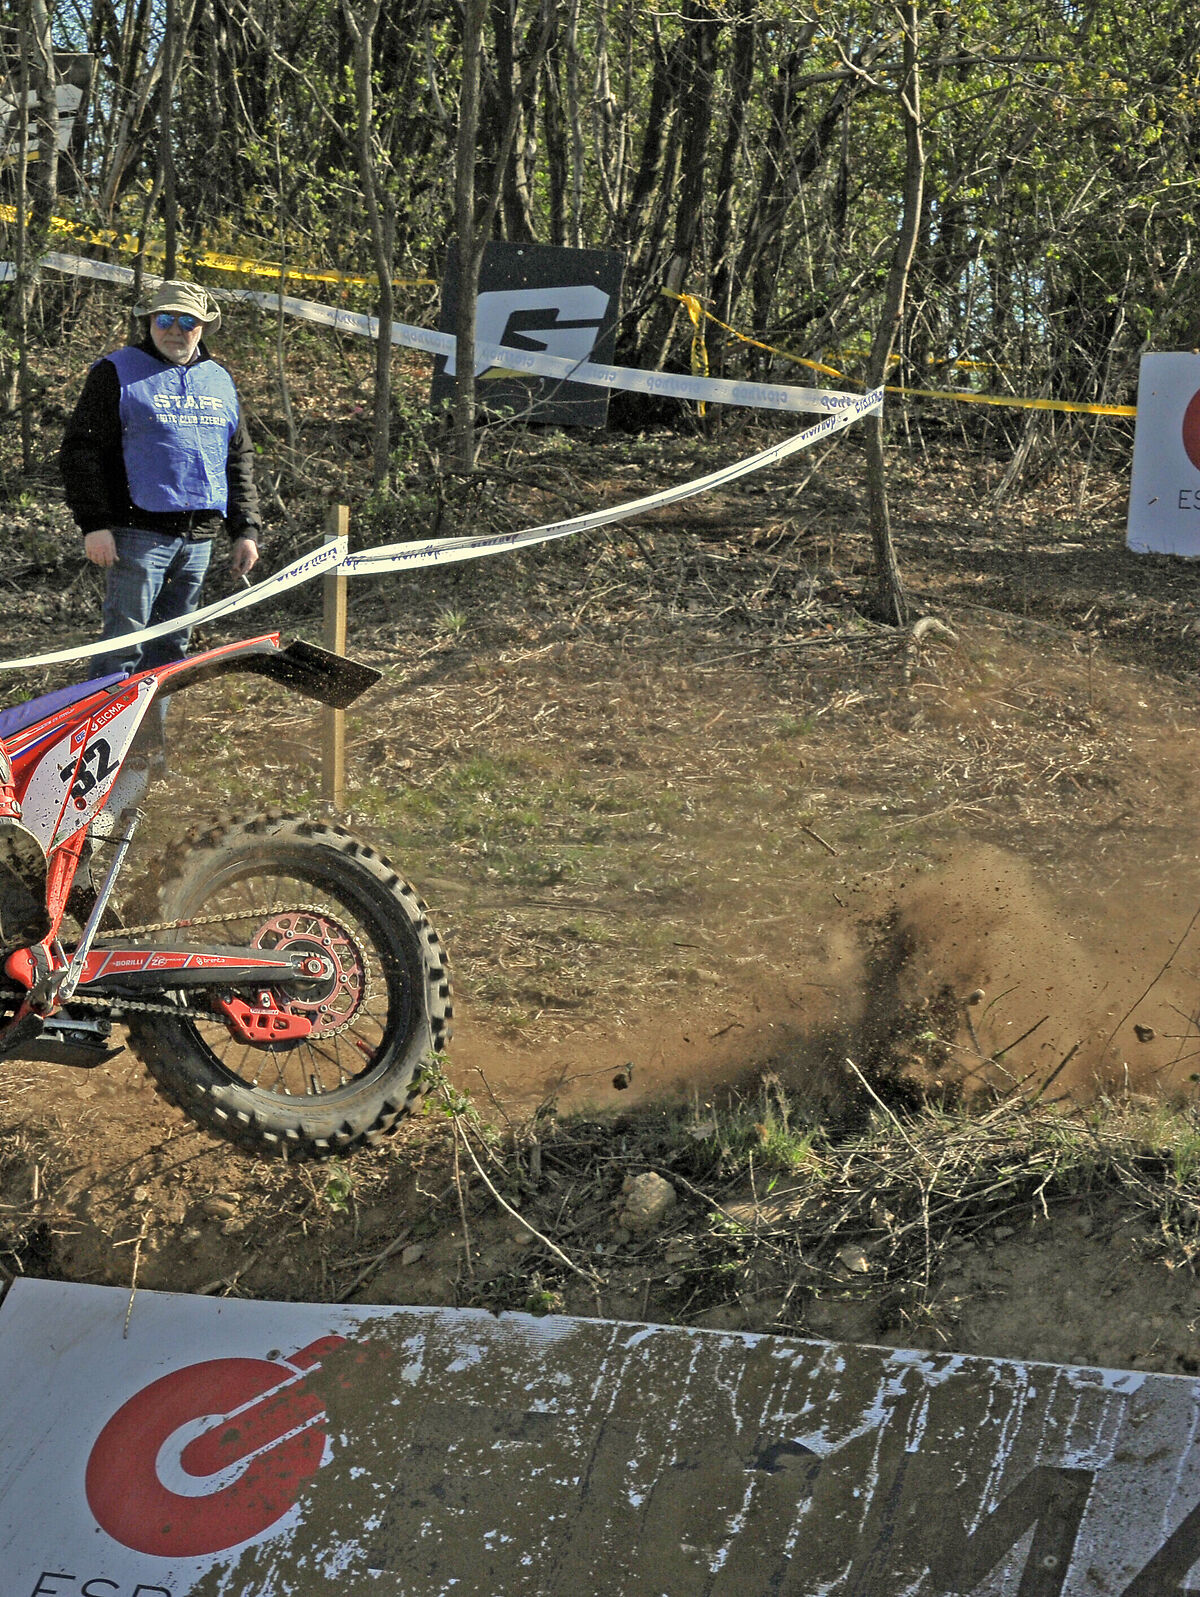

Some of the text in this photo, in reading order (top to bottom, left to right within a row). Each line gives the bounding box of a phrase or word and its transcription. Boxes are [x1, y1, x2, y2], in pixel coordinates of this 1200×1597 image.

[153, 393, 223, 411] STAFF
[97, 701, 125, 726] EICMA
[60, 738, 120, 799] 32
